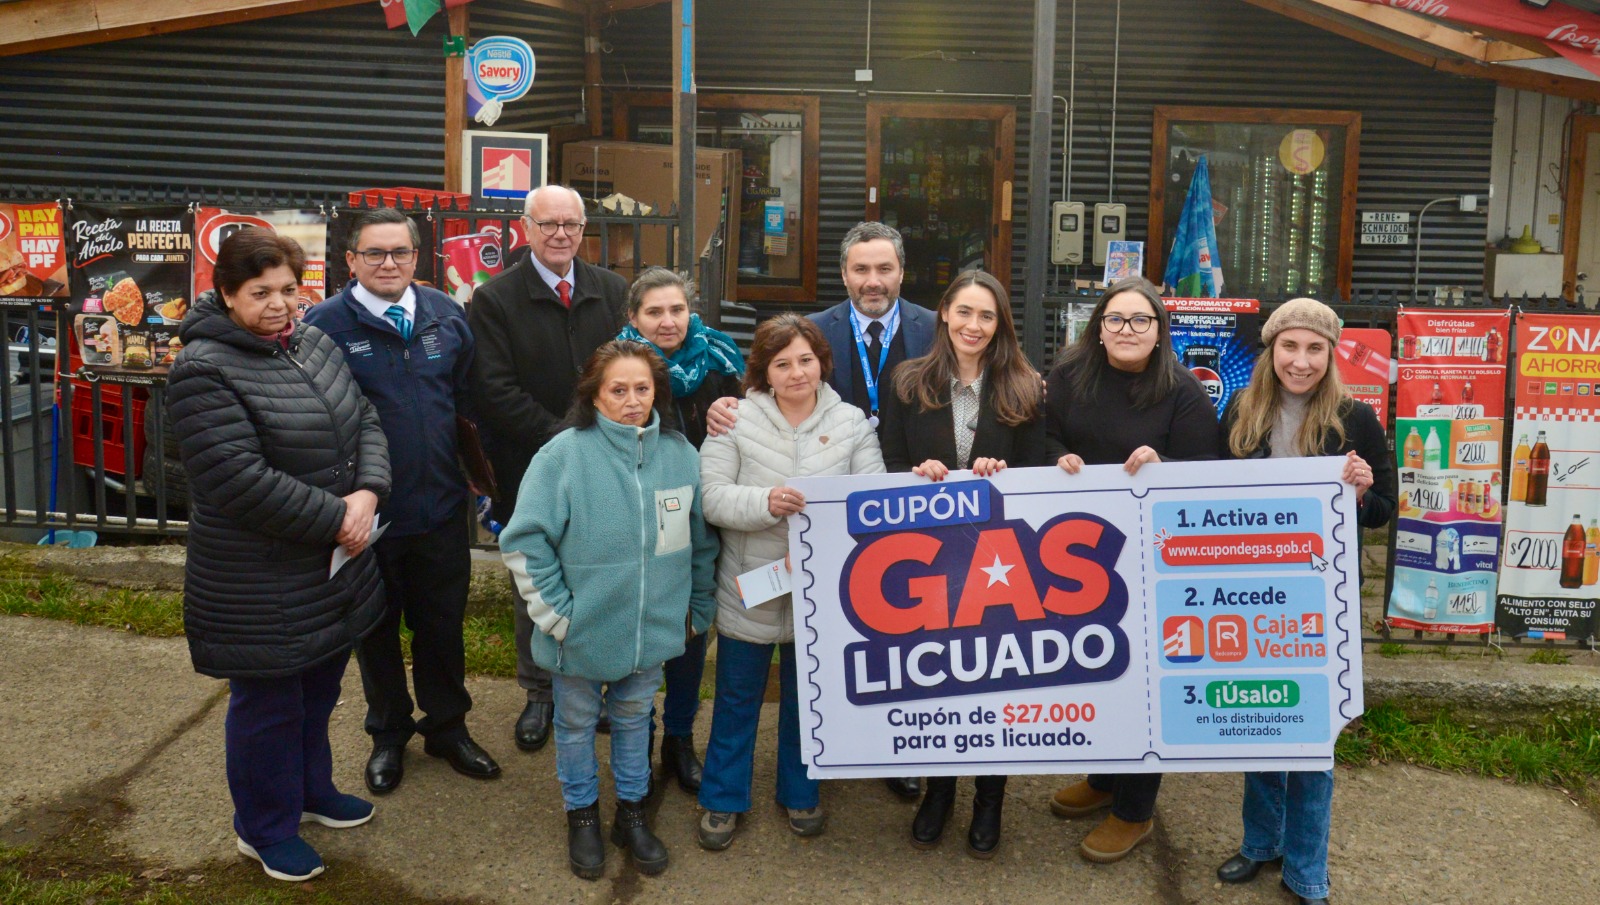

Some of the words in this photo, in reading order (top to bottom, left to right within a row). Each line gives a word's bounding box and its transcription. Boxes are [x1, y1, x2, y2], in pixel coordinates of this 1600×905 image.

[479, 64, 520, 81] Savory
[17, 208, 57, 223] HAY
[1375, 213, 1396, 221] RENE
[19, 222, 60, 237] PAN
[72, 217, 122, 243] Receta
[136, 219, 148, 233] LA
[150, 219, 181, 233] RECETA
[1362, 224, 1409, 233] SCHNEIDER
[95, 232, 113, 243] del
[127, 232, 192, 250] PERFECTA
[21, 239, 60, 254] HAY
[79, 238, 124, 260] Abuelo
[29, 254, 56, 268] PF
[135, 254, 149, 262] PARA
[165, 254, 185, 262] JUNTA
[1162, 299, 1188, 307] UEVO
[1427, 319, 1475, 328] Disfrútalas
[1526, 357, 1600, 374] AHORR
[1363, 397, 1382, 405] con
[857, 487, 981, 527] CUPÓN
[1177, 508, 1196, 528] 1.
[1202, 508, 1268, 527] Activa
[1274, 511, 1298, 525] en
[1168, 539, 1313, 559] www.cupondegas.gob.cl
[1475, 560, 1493, 569] vital
[849, 518, 1111, 635] GAS
[1448, 578, 1489, 589] BENEDICTINO
[1184, 587, 1204, 607] 2.
[1212, 586, 1287, 606] Accede
[1500, 597, 1546, 608] ALIMENTO
[1547, 600, 1567, 608] CON
[1568, 601, 1596, 609] SELLO
[1553, 609, 1579, 618] EVITA
[1580, 610, 1592, 618] SU
[1253, 614, 1299, 639] Caja
[1524, 617, 1571, 626] CONSUMO.
[1254, 638, 1326, 659] Vecina
[853, 623, 1116, 695] LICUADO
[1183, 685, 1203, 704] 3.
[1215, 681, 1289, 708] ¡Úsalo!
[887, 708, 961, 730] Cupón
[968, 707, 997, 725] de
[1002, 702, 1096, 726] $27.000
[1196, 714, 1211, 724] en
[1212, 713, 1228, 724] los
[1230, 712, 1304, 724] distribuidores
[1219, 725, 1282, 736] autorizados
[893, 732, 947, 754] para
[953, 732, 995, 754] gas
[1002, 727, 1093, 749] licuado.
